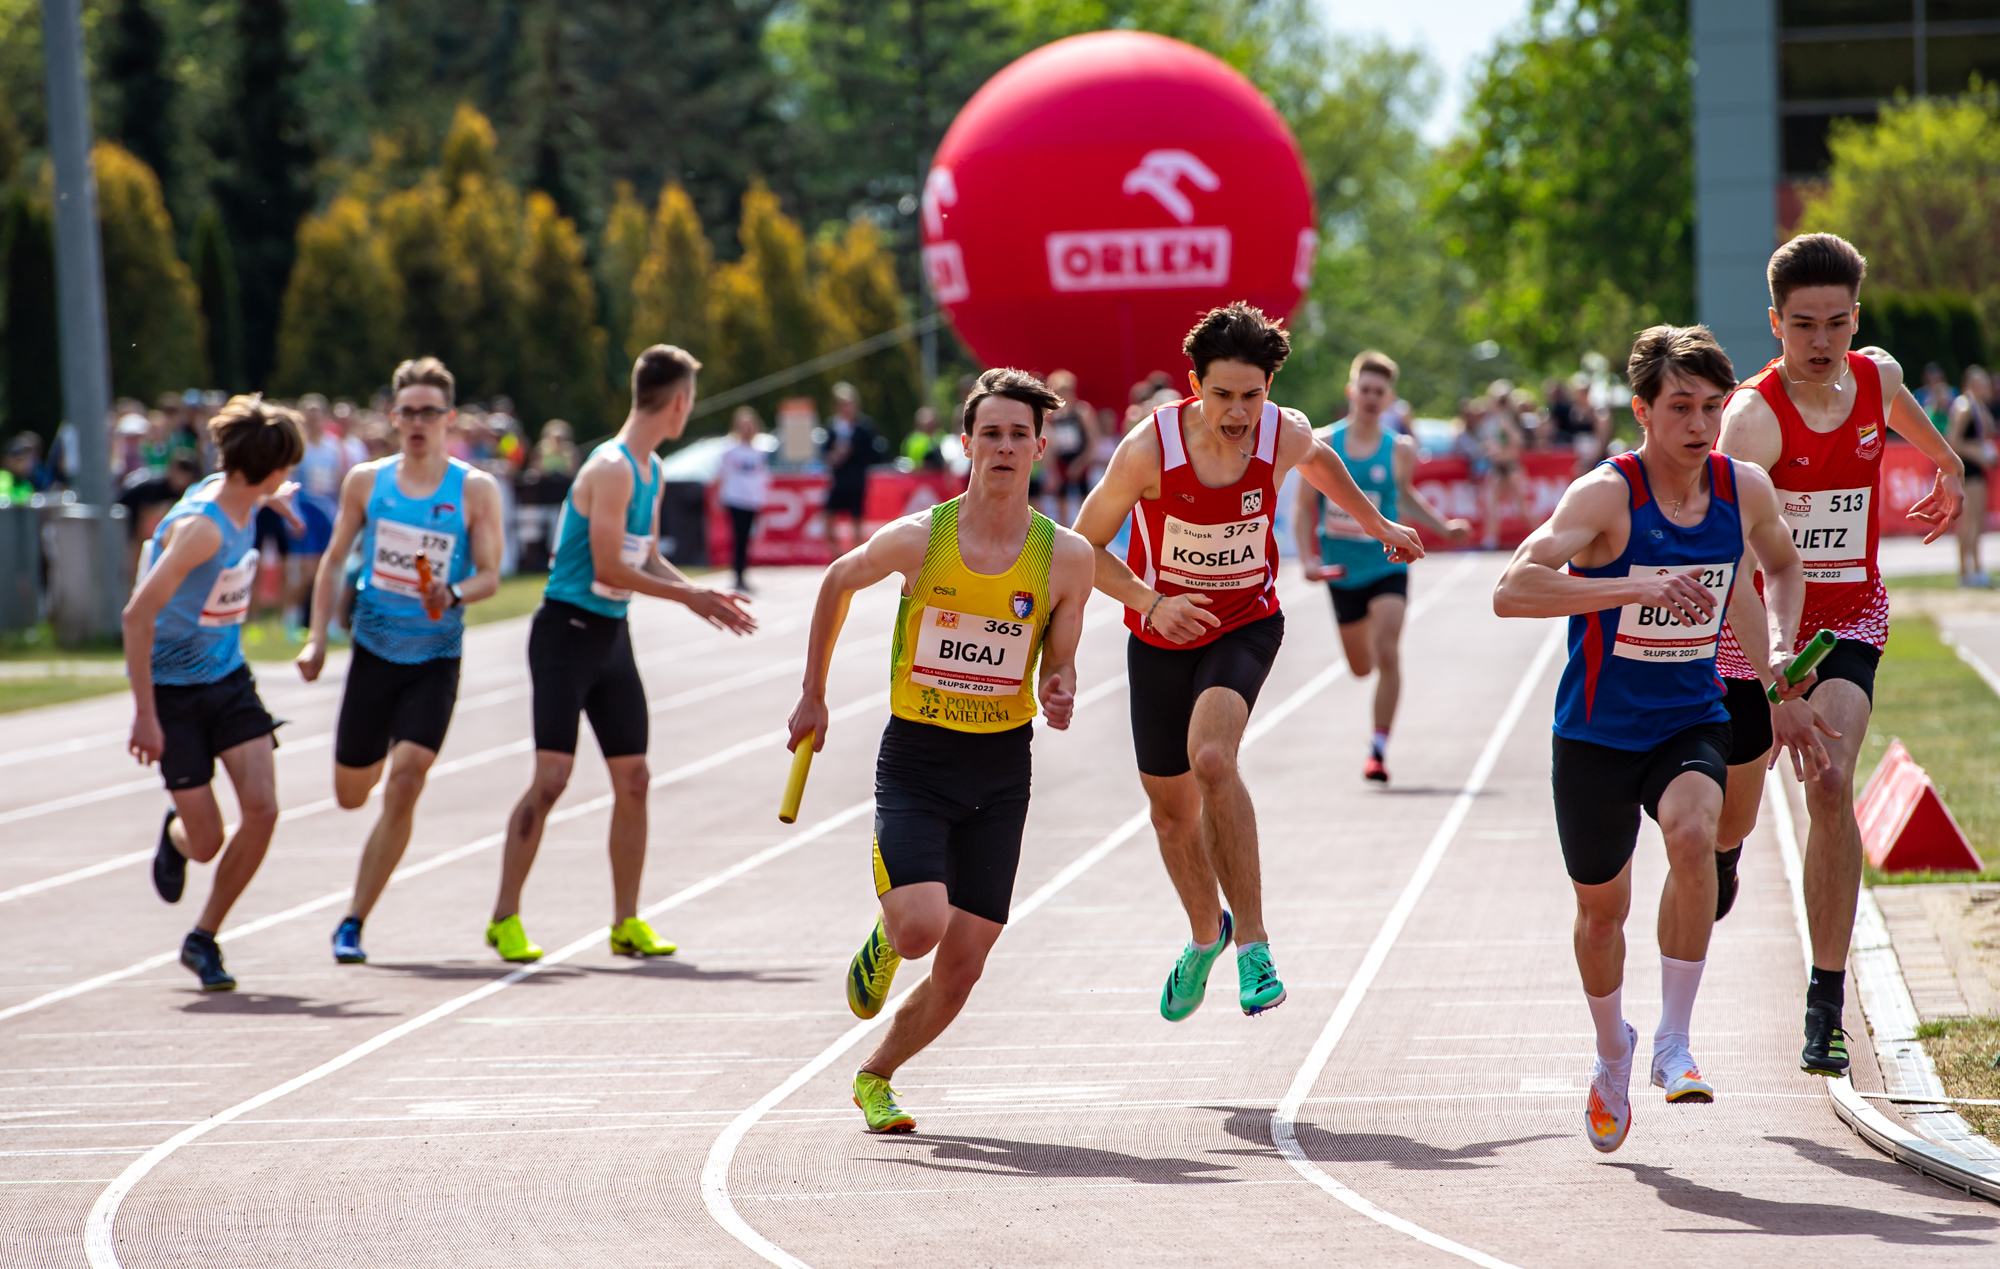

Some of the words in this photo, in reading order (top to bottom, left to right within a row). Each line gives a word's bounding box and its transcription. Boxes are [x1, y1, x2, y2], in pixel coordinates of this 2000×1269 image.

[1061, 241, 1215, 278] ORLEN
[1786, 504, 1811, 512] ORLEN
[1829, 493, 1864, 512] 513
[1783, 510, 1810, 518] FUNDACJA
[1183, 529, 1212, 539] Słupsk
[1223, 522, 1260, 539] 373
[1792, 528, 1848, 549] LIETZ
[1172, 545, 1255, 567] KOSELA
[1184, 579, 1217, 587] SŁUPSK
[933, 586, 956, 596] esa
[984, 620, 1023, 637] 365
[939, 639, 1005, 666] BIGAJ
[1643, 649, 1678, 657] SŁUPSK
[1679, 649, 1698, 657] 2023
[937, 679, 971, 690] SŁUPSK
[972, 684, 994, 692] 2023
[946, 697, 1002, 711] POWIAT
[944, 707, 1009, 723] WIELICKI
